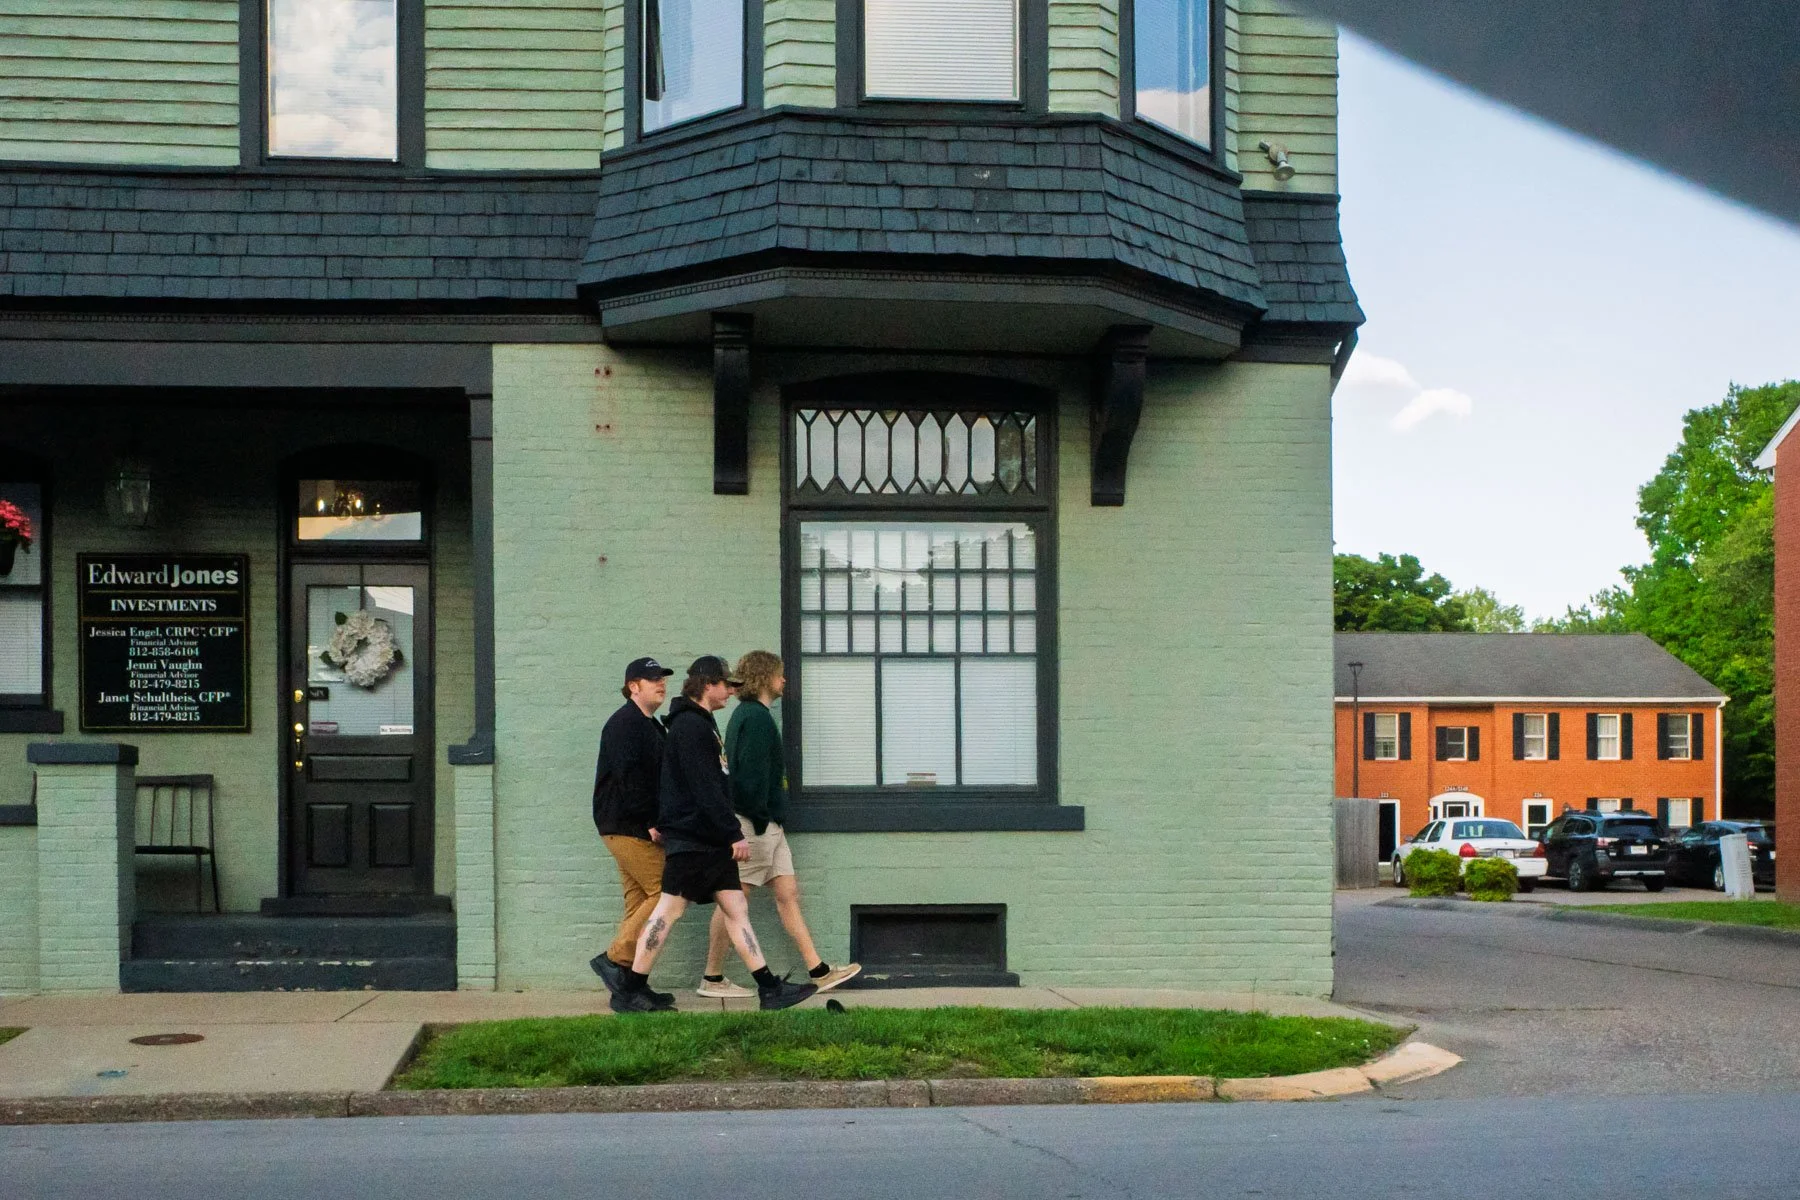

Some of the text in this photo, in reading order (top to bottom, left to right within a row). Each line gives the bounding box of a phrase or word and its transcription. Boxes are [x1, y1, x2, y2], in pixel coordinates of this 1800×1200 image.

[88, 563, 238, 587] Edward Jones
[111, 599, 217, 612] INVESTMENTS
[90, 627, 126, 637] Jessica
[130, 627, 162, 638] Engel,
[129, 647, 199, 656] 812-858-6104
[126, 659, 202, 672] Jenni Vaughn
[129, 679, 200, 689] 812-479-8215
[98, 692, 129, 703] Janet
[133, 692, 195, 703] Schultheis,
[130, 712, 200, 721] 812-479-8215
